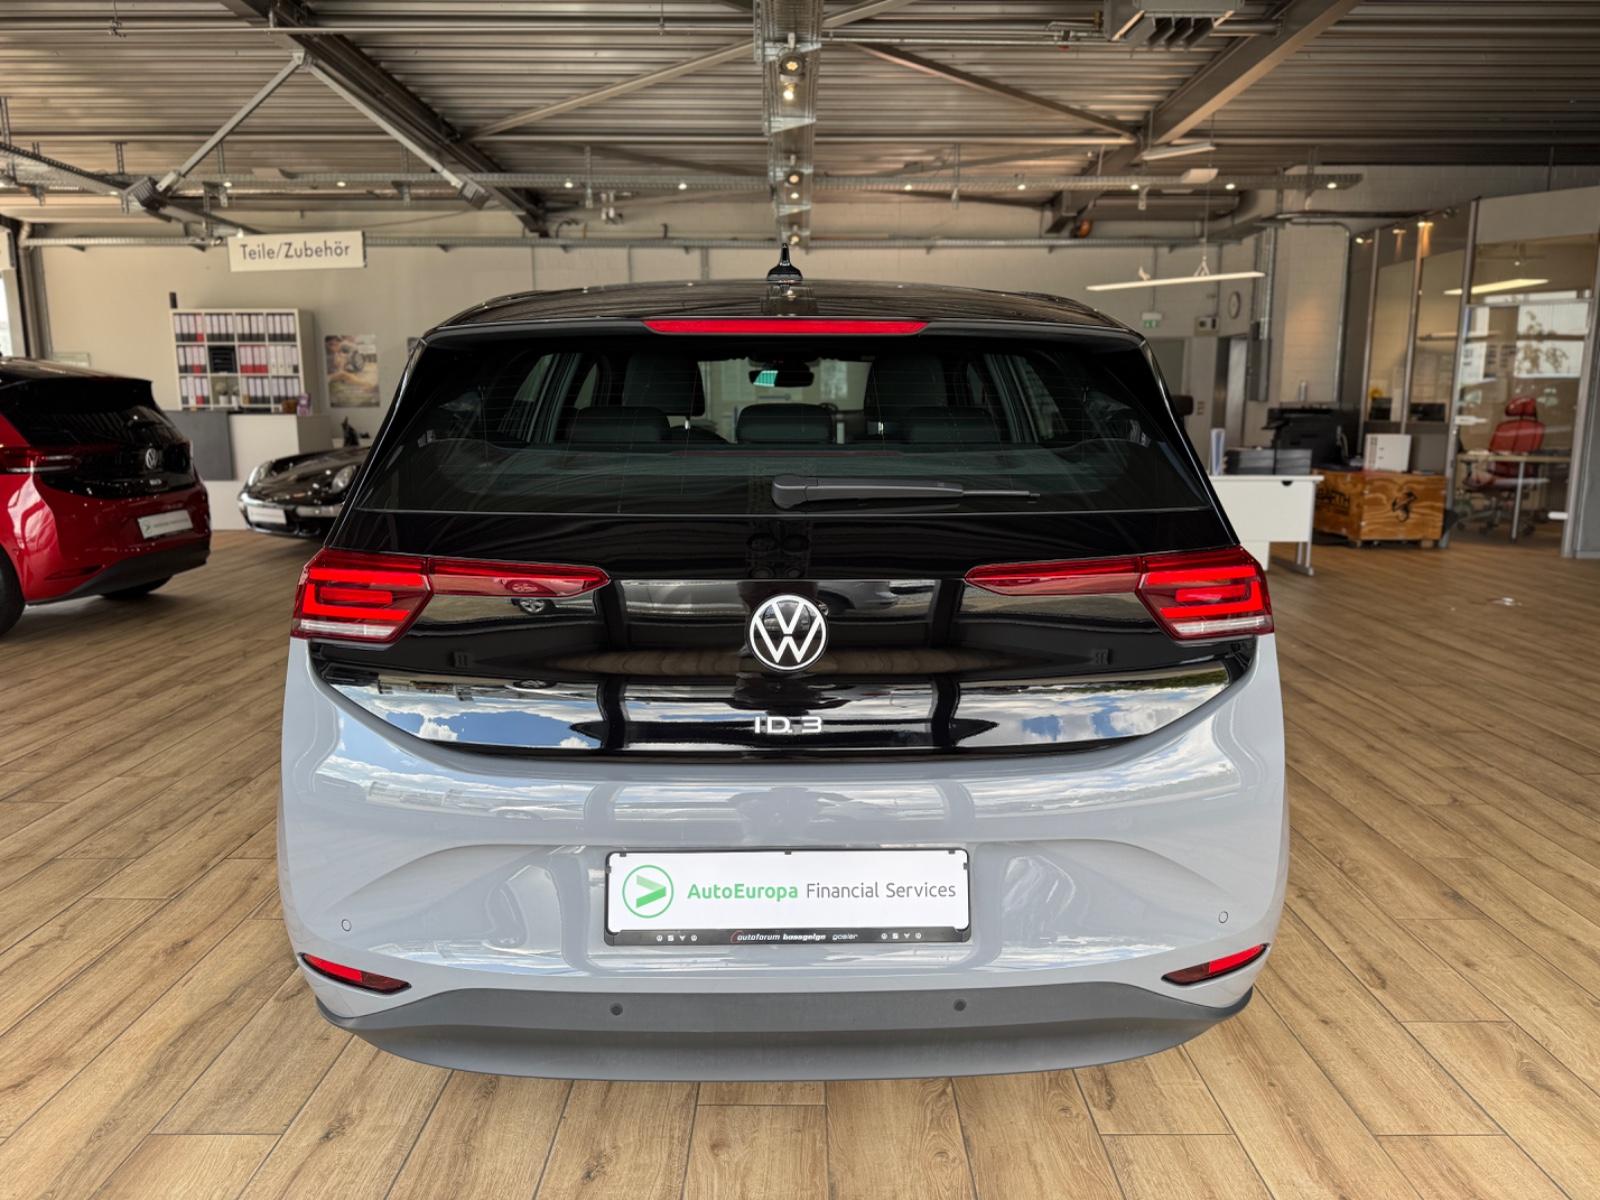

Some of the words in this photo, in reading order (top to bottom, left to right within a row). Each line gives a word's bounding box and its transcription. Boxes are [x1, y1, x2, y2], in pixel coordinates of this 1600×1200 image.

[240, 240, 351, 261] Teile/Zubehör
[750, 595, 826, 670] VW
[687, 883, 798, 902] AutoEuropa
[806, 882, 879, 899] Financial
[886, 882, 956, 898] Services
[737, 933, 780, 941] autoforum
